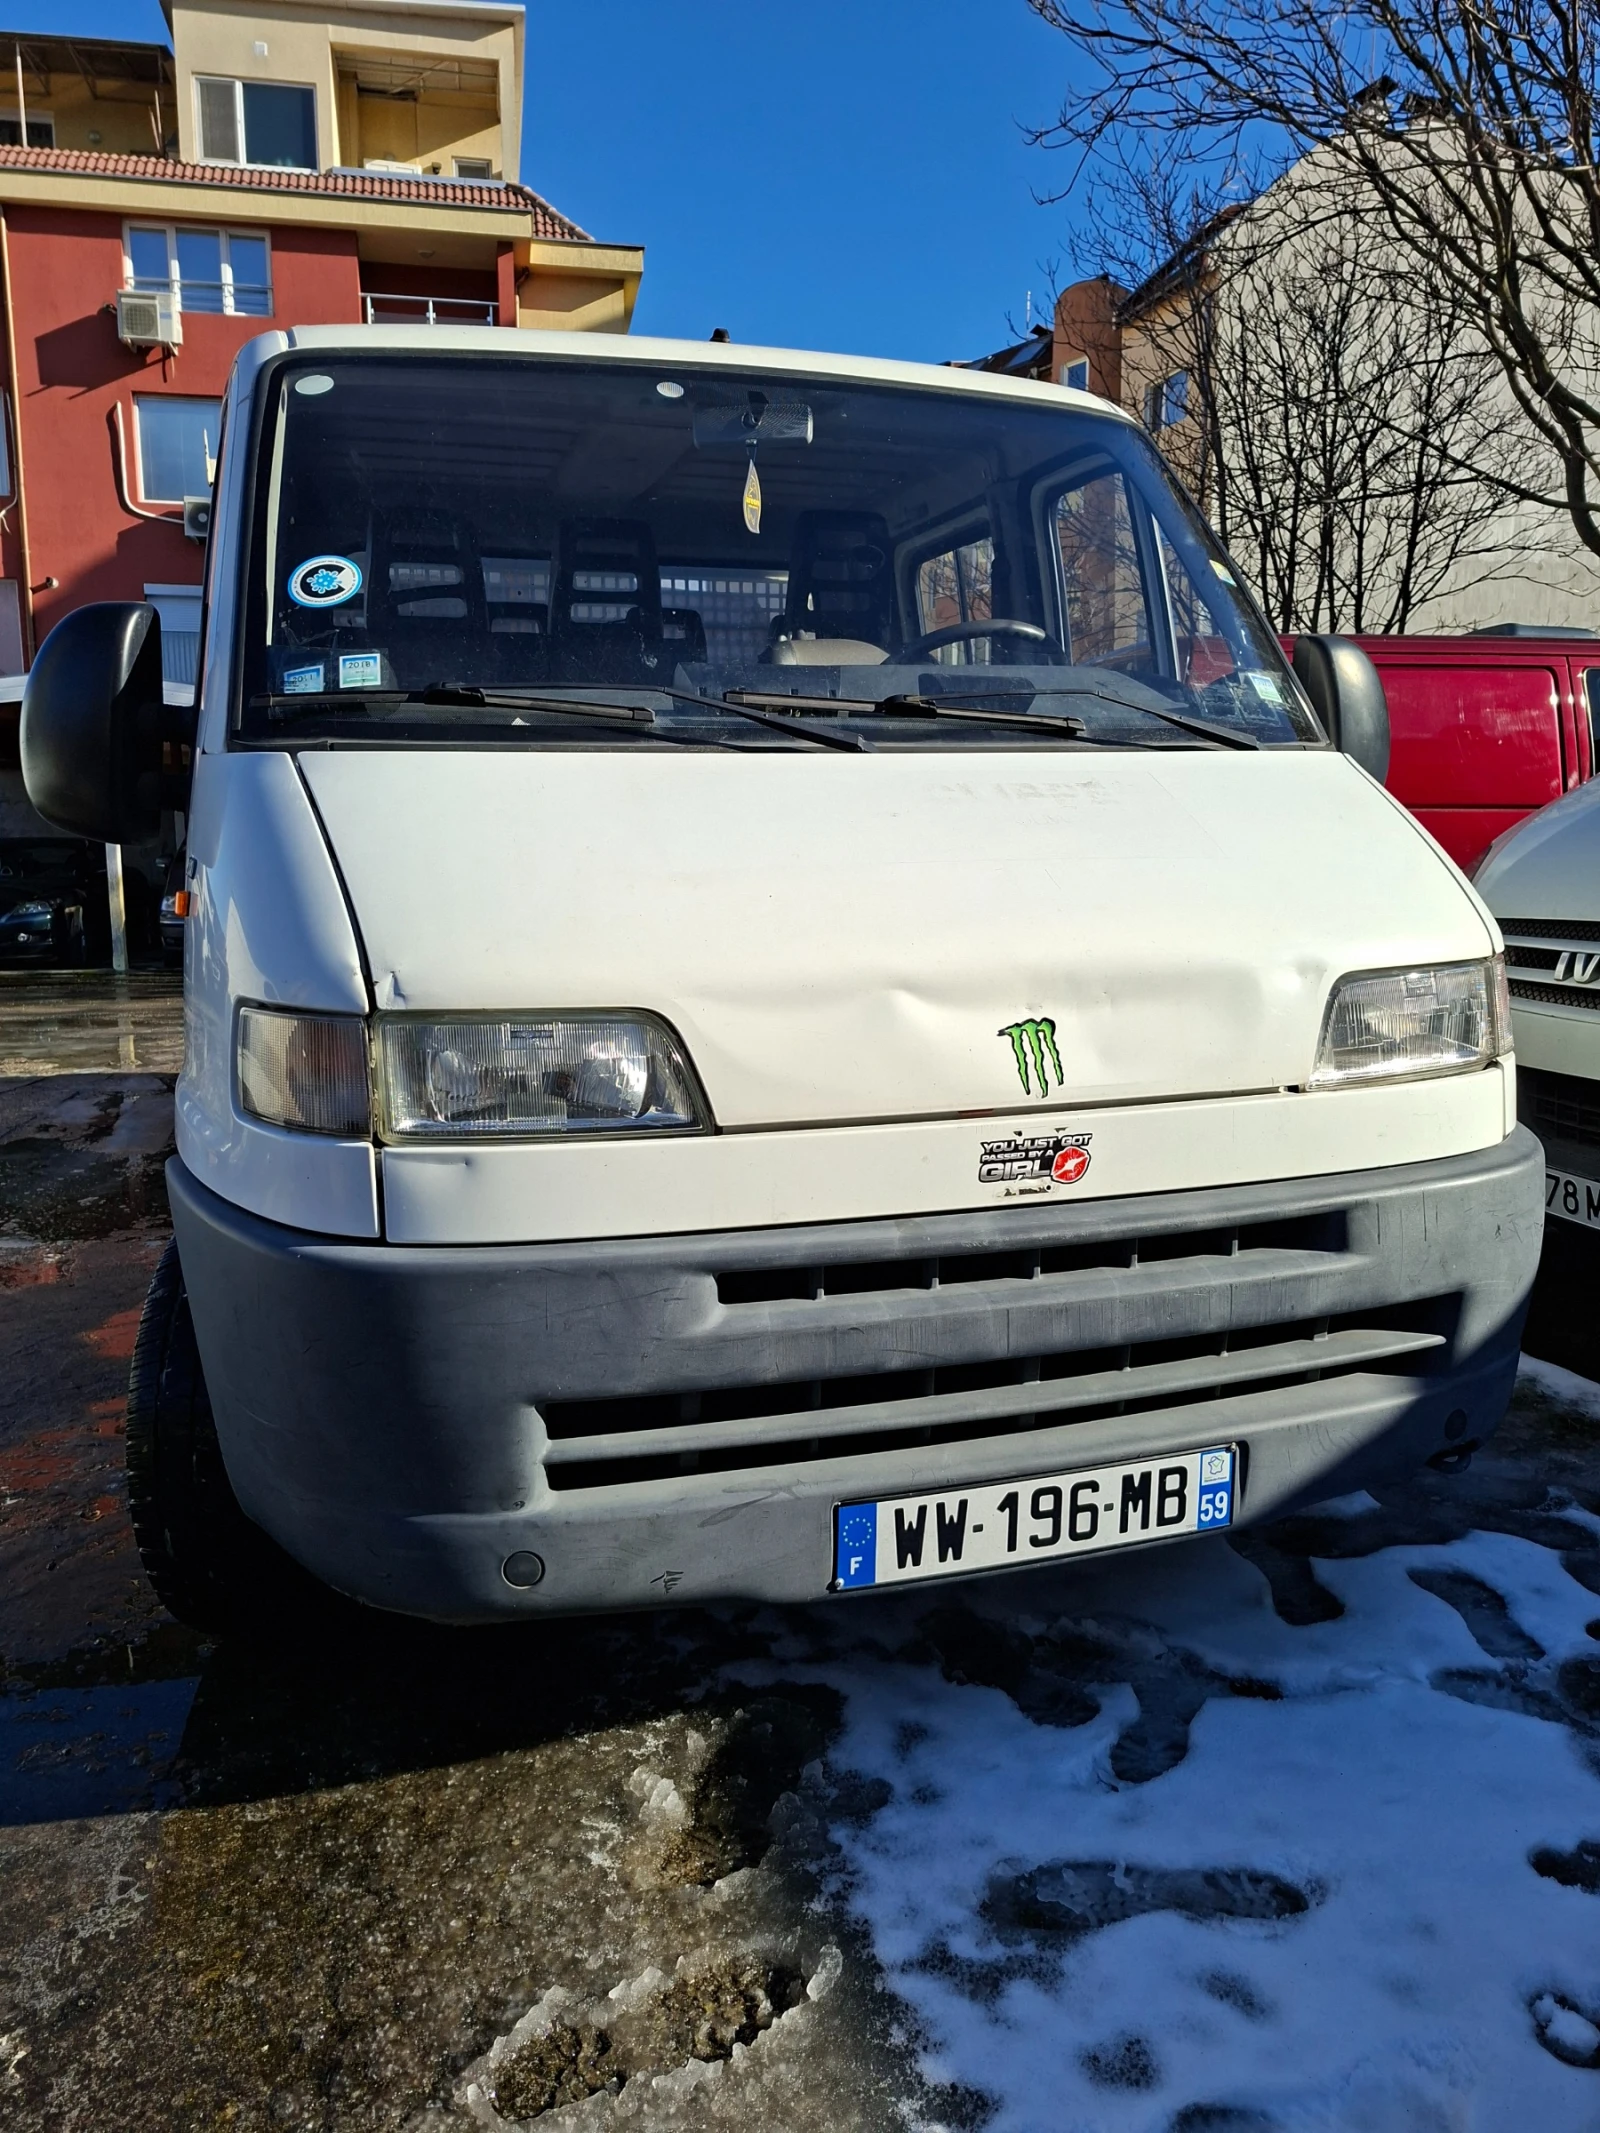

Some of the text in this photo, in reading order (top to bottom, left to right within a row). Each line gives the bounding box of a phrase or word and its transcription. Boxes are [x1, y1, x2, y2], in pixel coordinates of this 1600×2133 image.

[983, 1134, 1092, 1153] YOU JUST GOT
[981, 1149, 1054, 1162] PASSED BY A
[980, 1159, 1050, 1181] GIRL
[849, 1556, 863, 1575] F
[1200, 1490, 1228, 1522] 59
